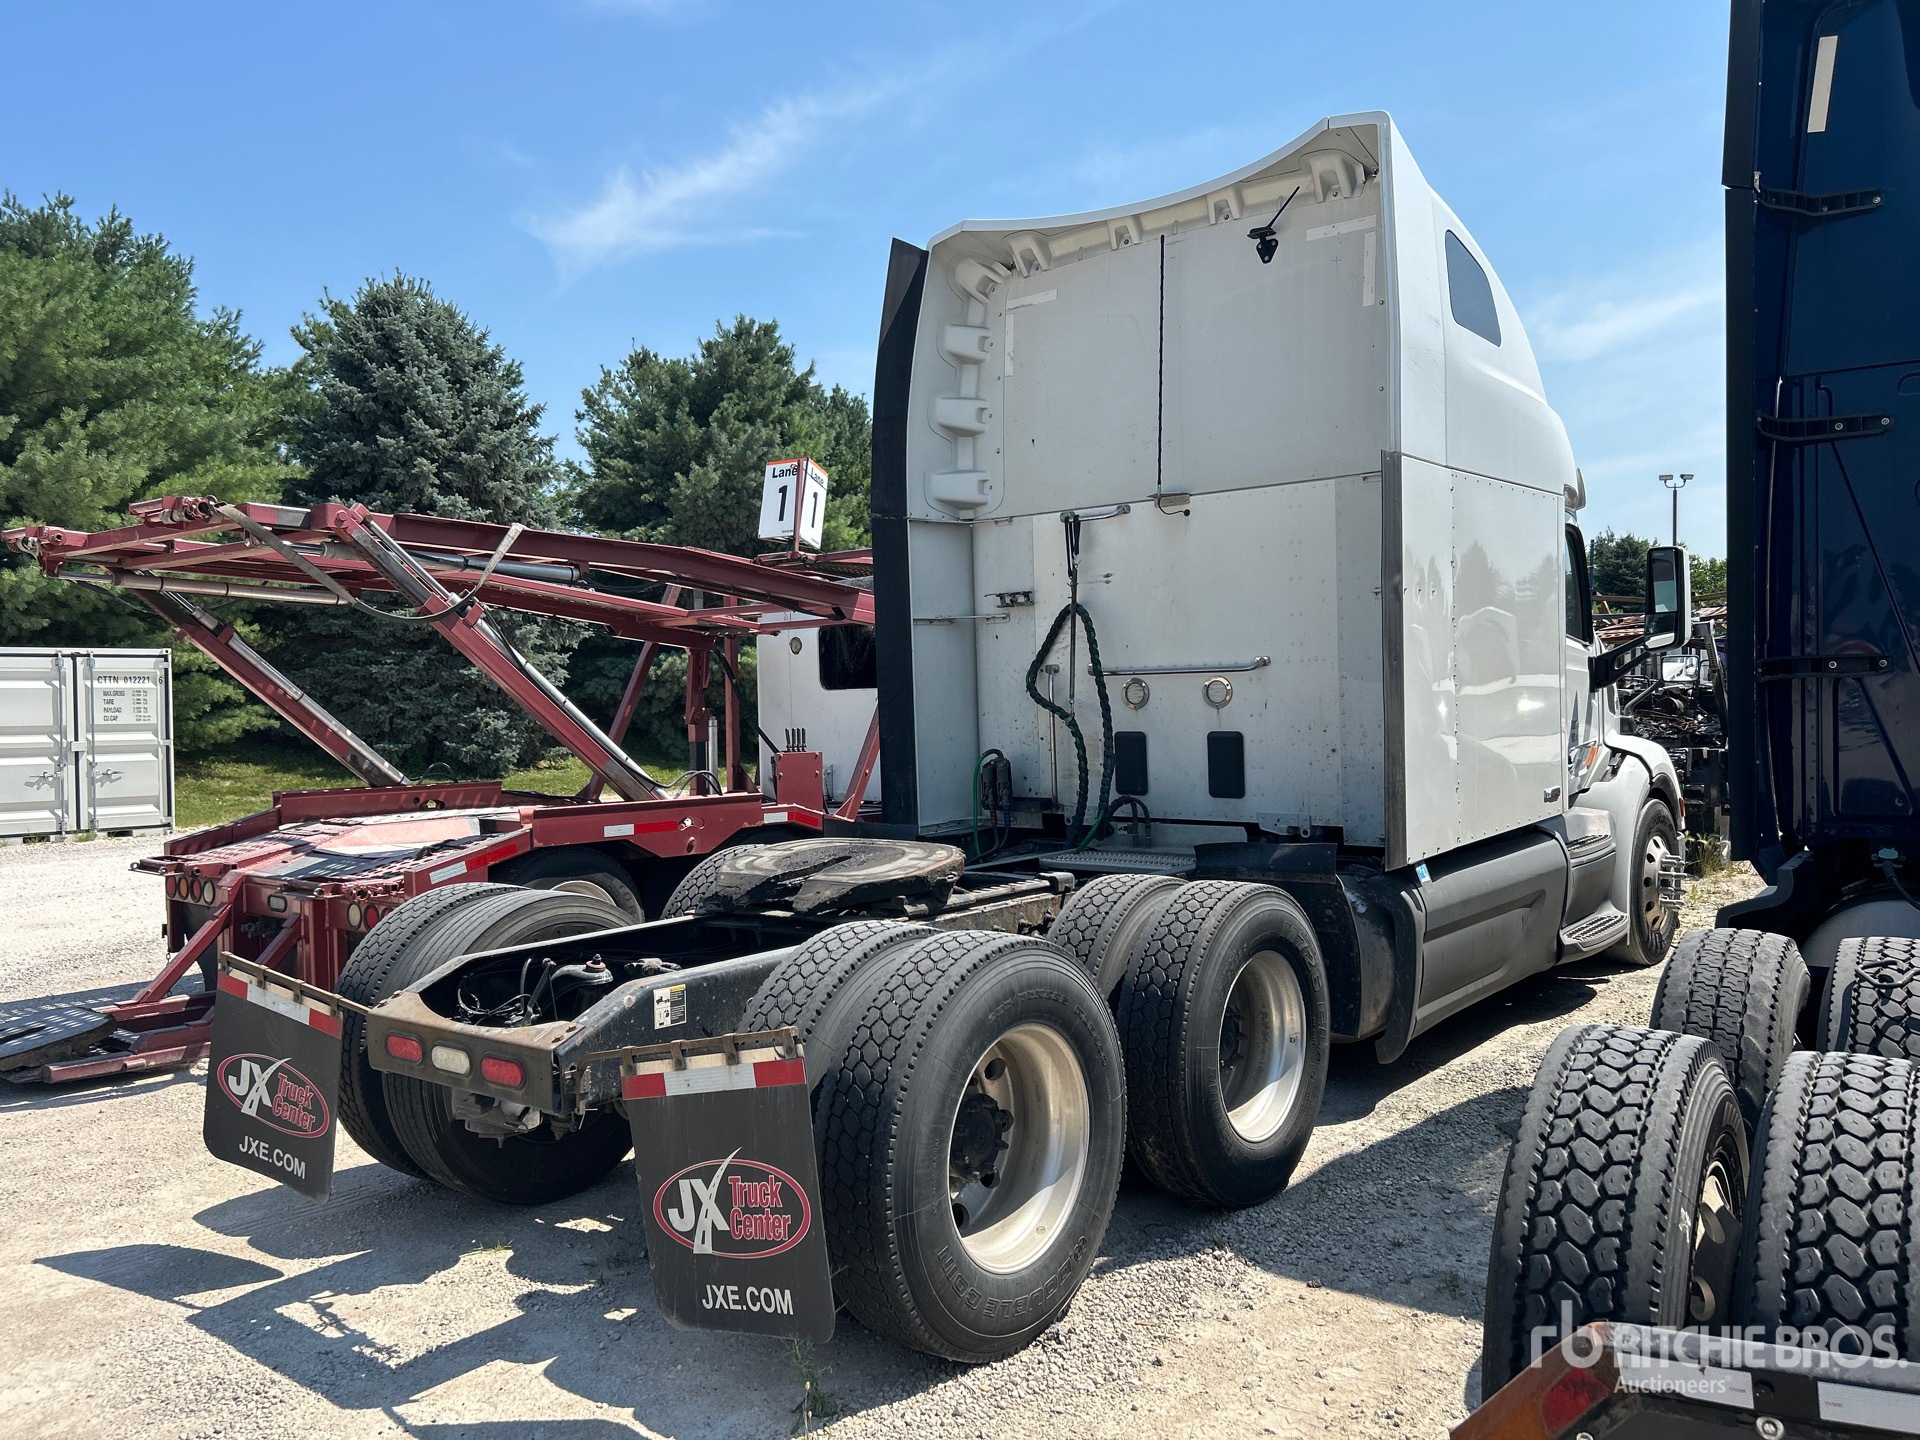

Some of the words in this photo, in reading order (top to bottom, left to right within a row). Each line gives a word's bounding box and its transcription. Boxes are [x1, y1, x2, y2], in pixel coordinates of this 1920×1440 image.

[772, 467, 798, 478] Lane
[778, 484, 788, 521] 1
[811, 491, 818, 528] 1
[97, 675, 119, 684] CTTN
[123, 676, 150, 684] 012221
[158, 676, 164, 684] 6
[228, 1057, 293, 1117] JX
[278, 1072, 314, 1110] Truck
[271, 1093, 316, 1131] Center
[238, 1135, 306, 1180] JXE.COM
[667, 1146, 743, 1255] JX
[728, 1175, 783, 1208] Truck
[729, 1207, 792, 1242] Center
[702, 1284, 794, 1316] JXE.COM
